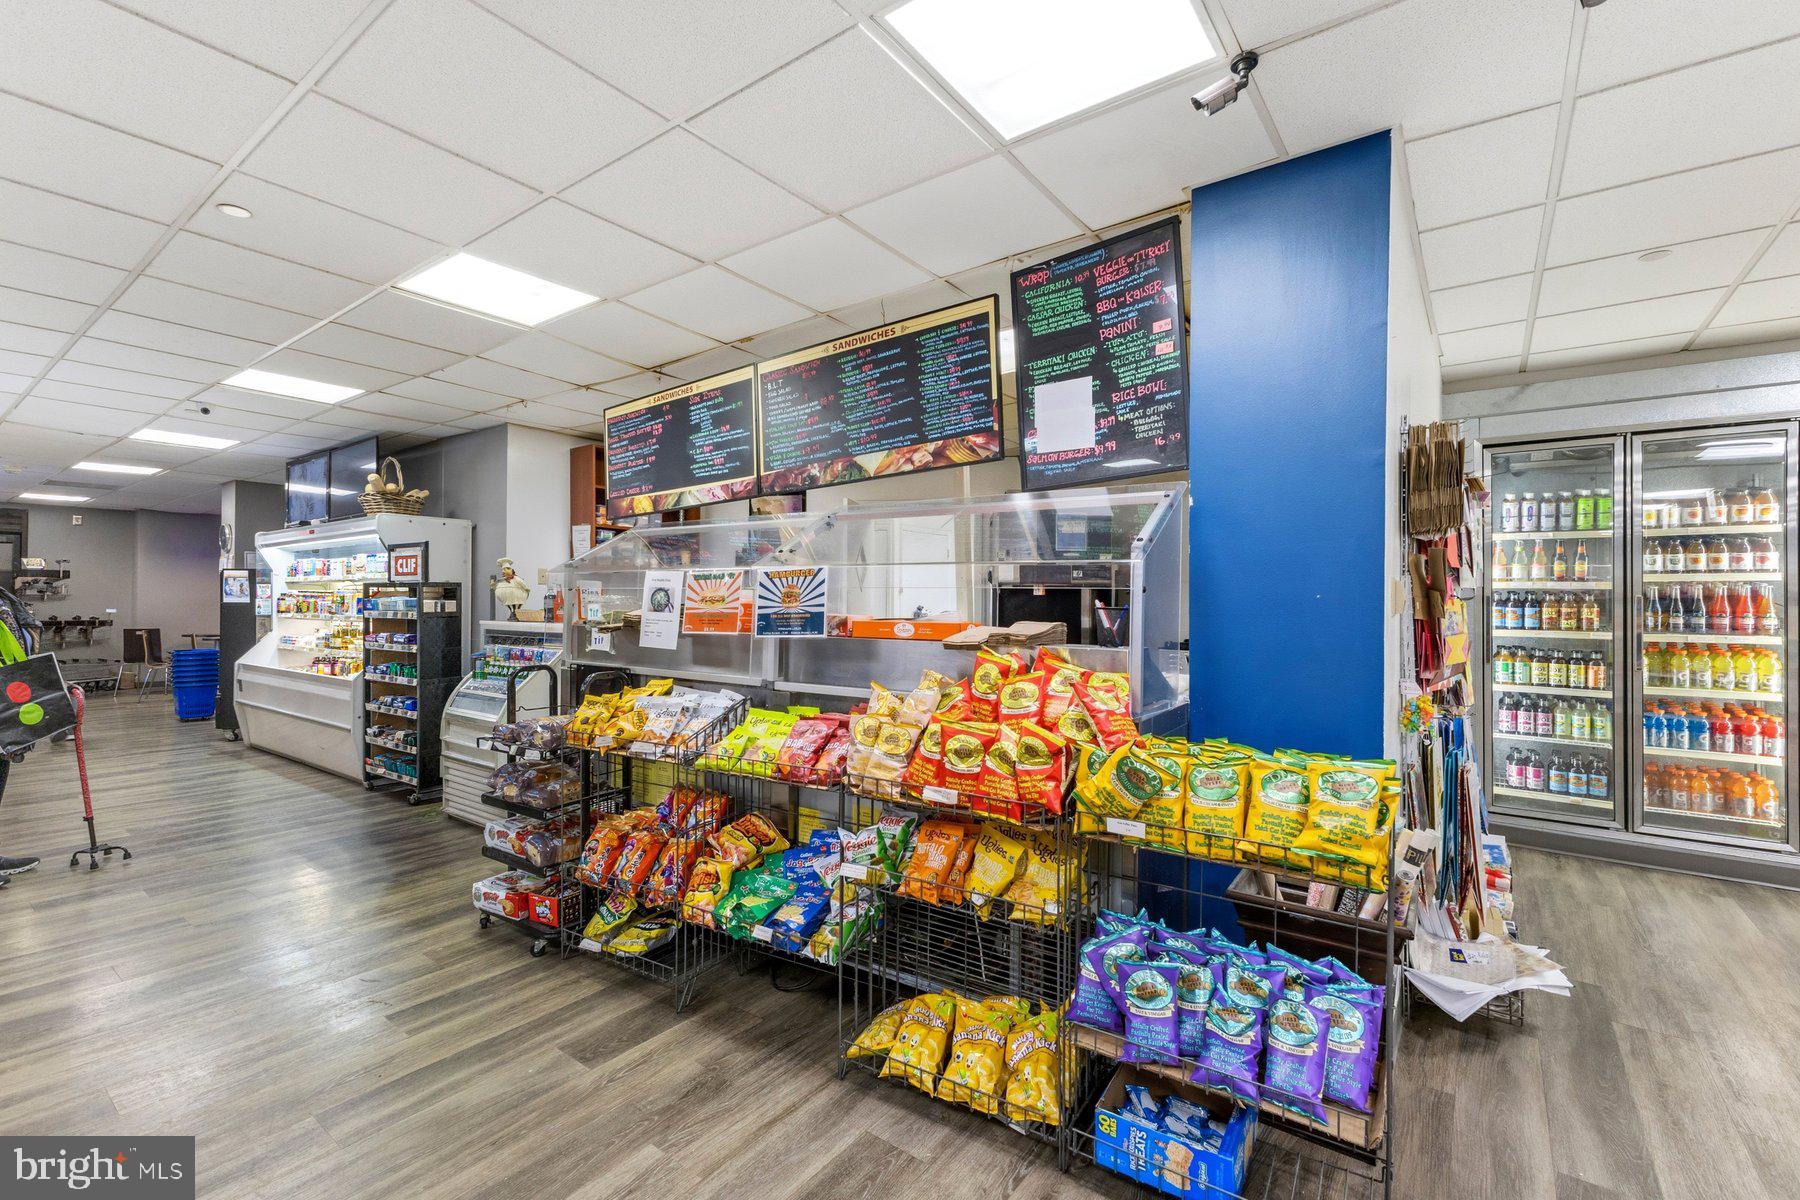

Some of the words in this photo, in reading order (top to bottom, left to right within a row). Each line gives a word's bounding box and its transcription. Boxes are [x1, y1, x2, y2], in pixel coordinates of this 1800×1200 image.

[1093, 256, 1127, 277] VEGGIE
[1096, 297, 1117, 313] BBQ
[832, 327, 896, 352] SANDWICHES
[652, 385, 694, 404] SANDWICHES
[1111, 387, 1136, 403] RICE
[1124, 409, 1144, 421] MEAT
[1154, 432, 1181, 446] 16.99
[1094, 440, 1116, 456] $9.99
[396, 558, 417, 574] CLIF
[768, 568, 815, 580] HAMBURGER
[1678, 672, 1688, 681] G
[1698, 672, 1706, 681] G
[1715, 735, 1724, 744] G
[1743, 737, 1752, 746] G
[1677, 792, 1686, 801] G
[1715, 794, 1724, 803] G
[980, 834, 1008, 859] Uglies
[985, 1028, 1006, 1048] Kick
[1034, 1037, 1057, 1052] Kick
[1098, 1114, 1110, 1134] 60
